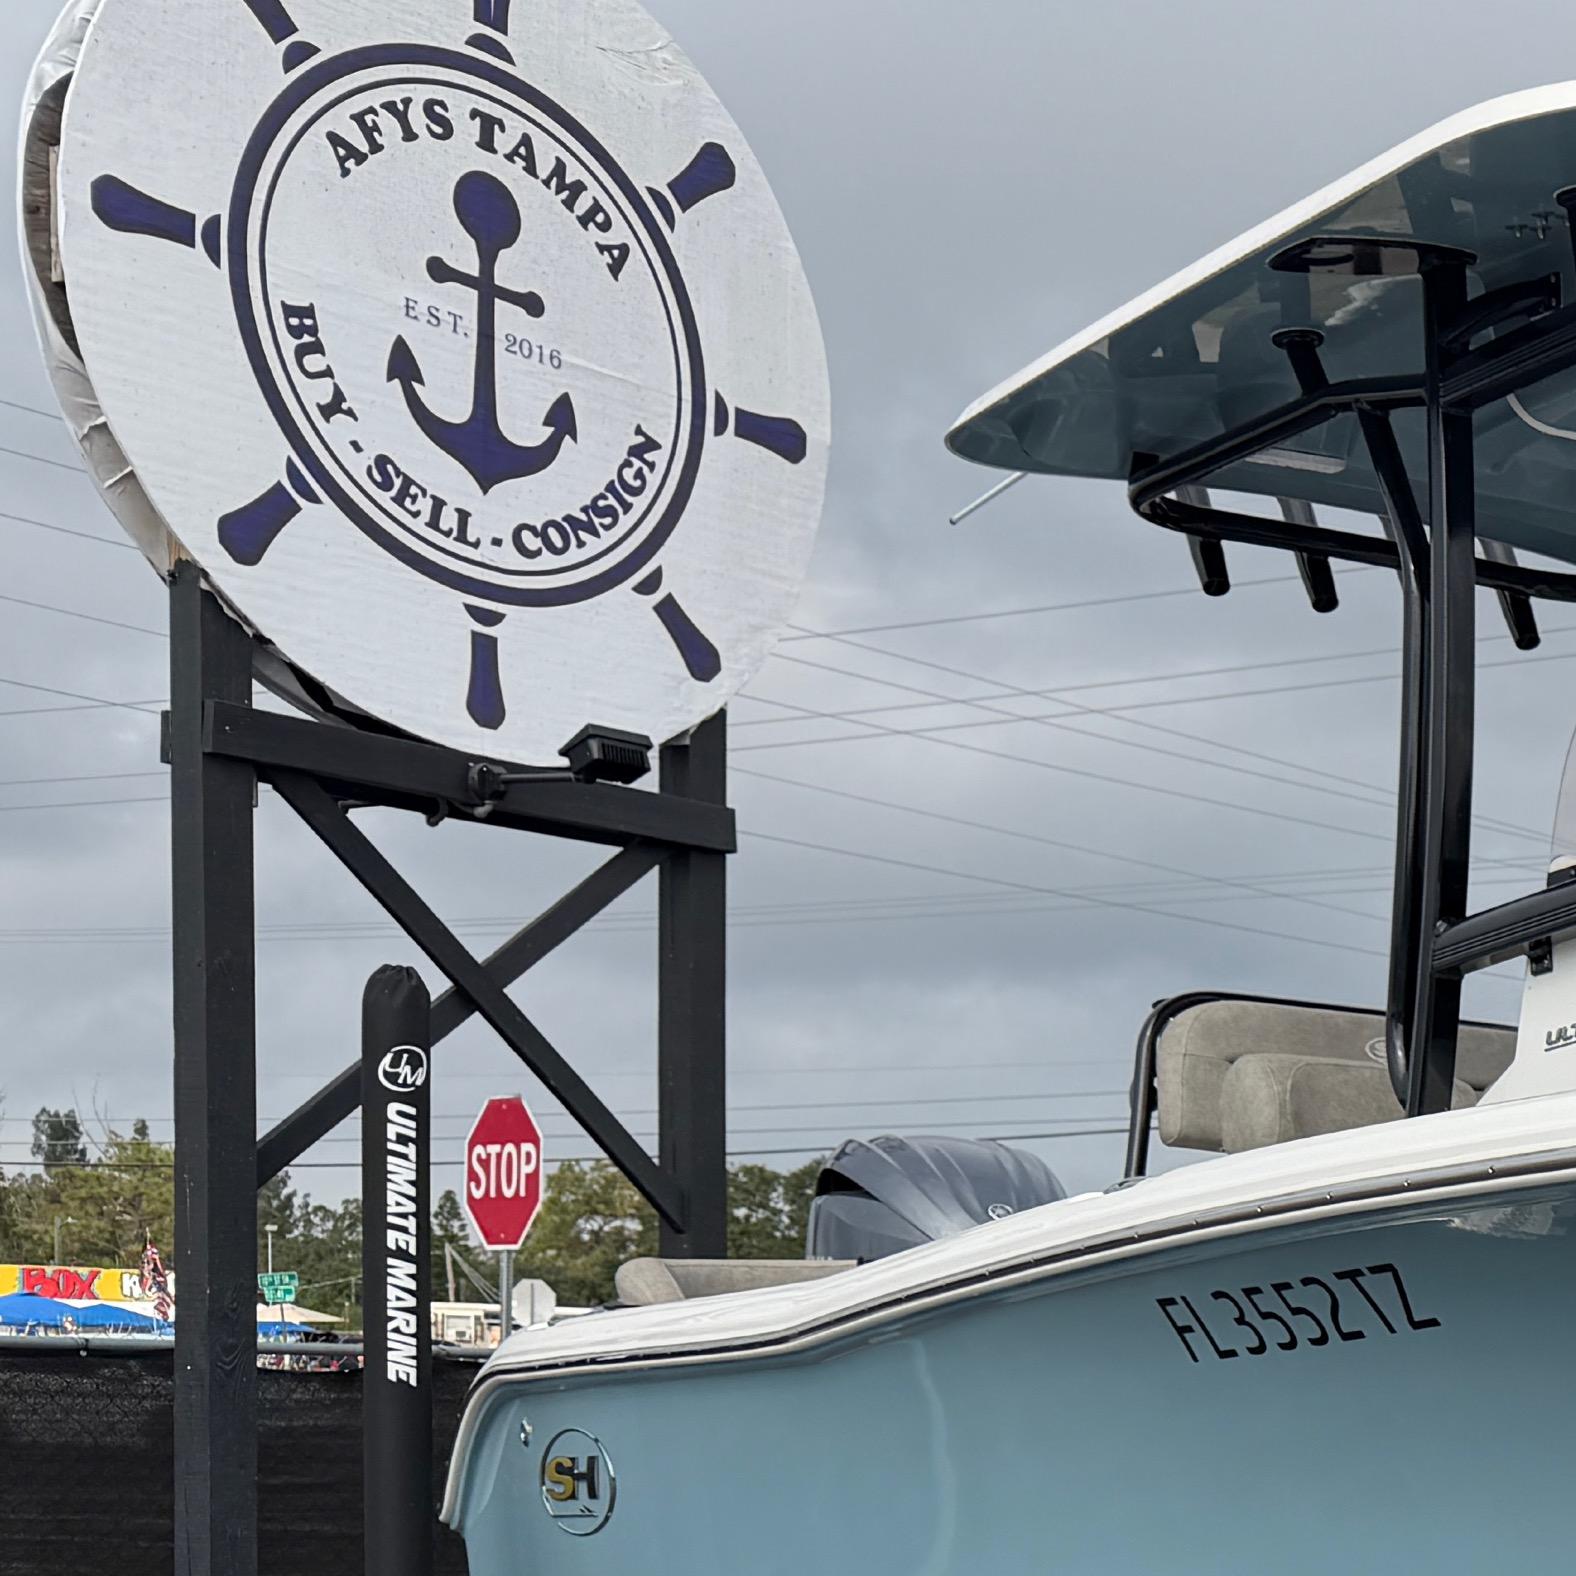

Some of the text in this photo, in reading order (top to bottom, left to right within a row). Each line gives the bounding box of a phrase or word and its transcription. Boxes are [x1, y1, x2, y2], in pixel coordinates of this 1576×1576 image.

[325, 97, 631, 282] AFYS TAMPA
[404, 296, 563, 370] EST. 2016
[280, 299, 359, 424] BUY
[366, 453, 482, 550] SELL
[511, 423, 663, 560] CONSIGN
[469, 1142, 538, 1200] STOP
[22, 1267, 102, 1300] BOX
[386, 1101, 418, 1388] ULTIMATE MARINE
